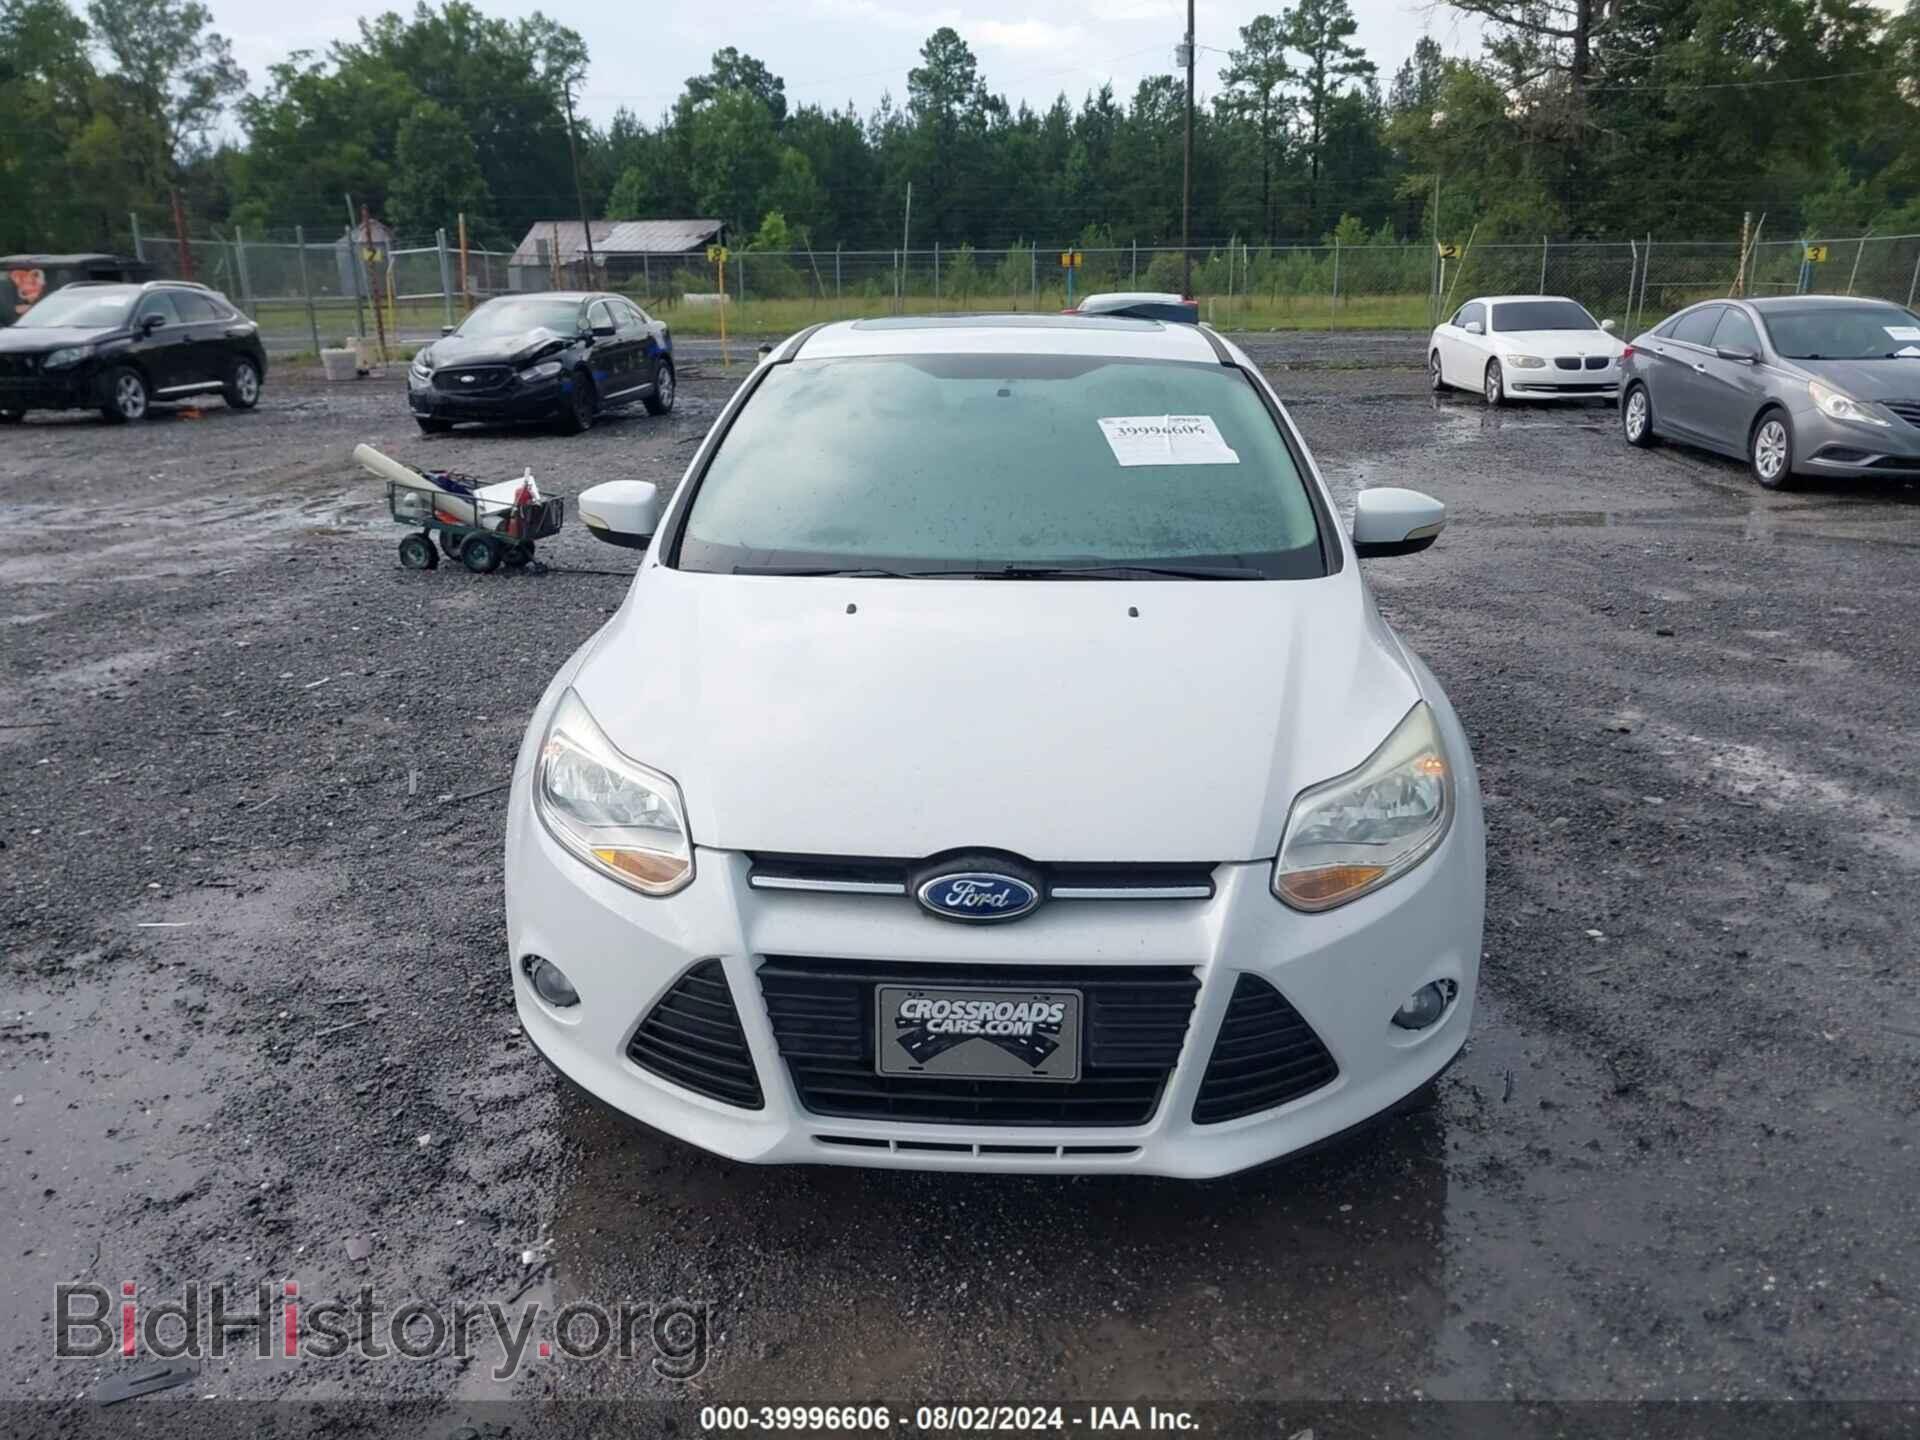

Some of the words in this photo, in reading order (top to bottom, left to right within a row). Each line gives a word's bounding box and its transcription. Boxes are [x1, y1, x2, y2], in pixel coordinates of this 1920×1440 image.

[1441, 246, 1456, 259] 2
[1808, 247, 1820, 261] 3
[945, 880, 1010, 907] Ford
[900, 999, 1065, 1024] CROSSROADS
[926, 1018, 1034, 1036] CARS.COM
